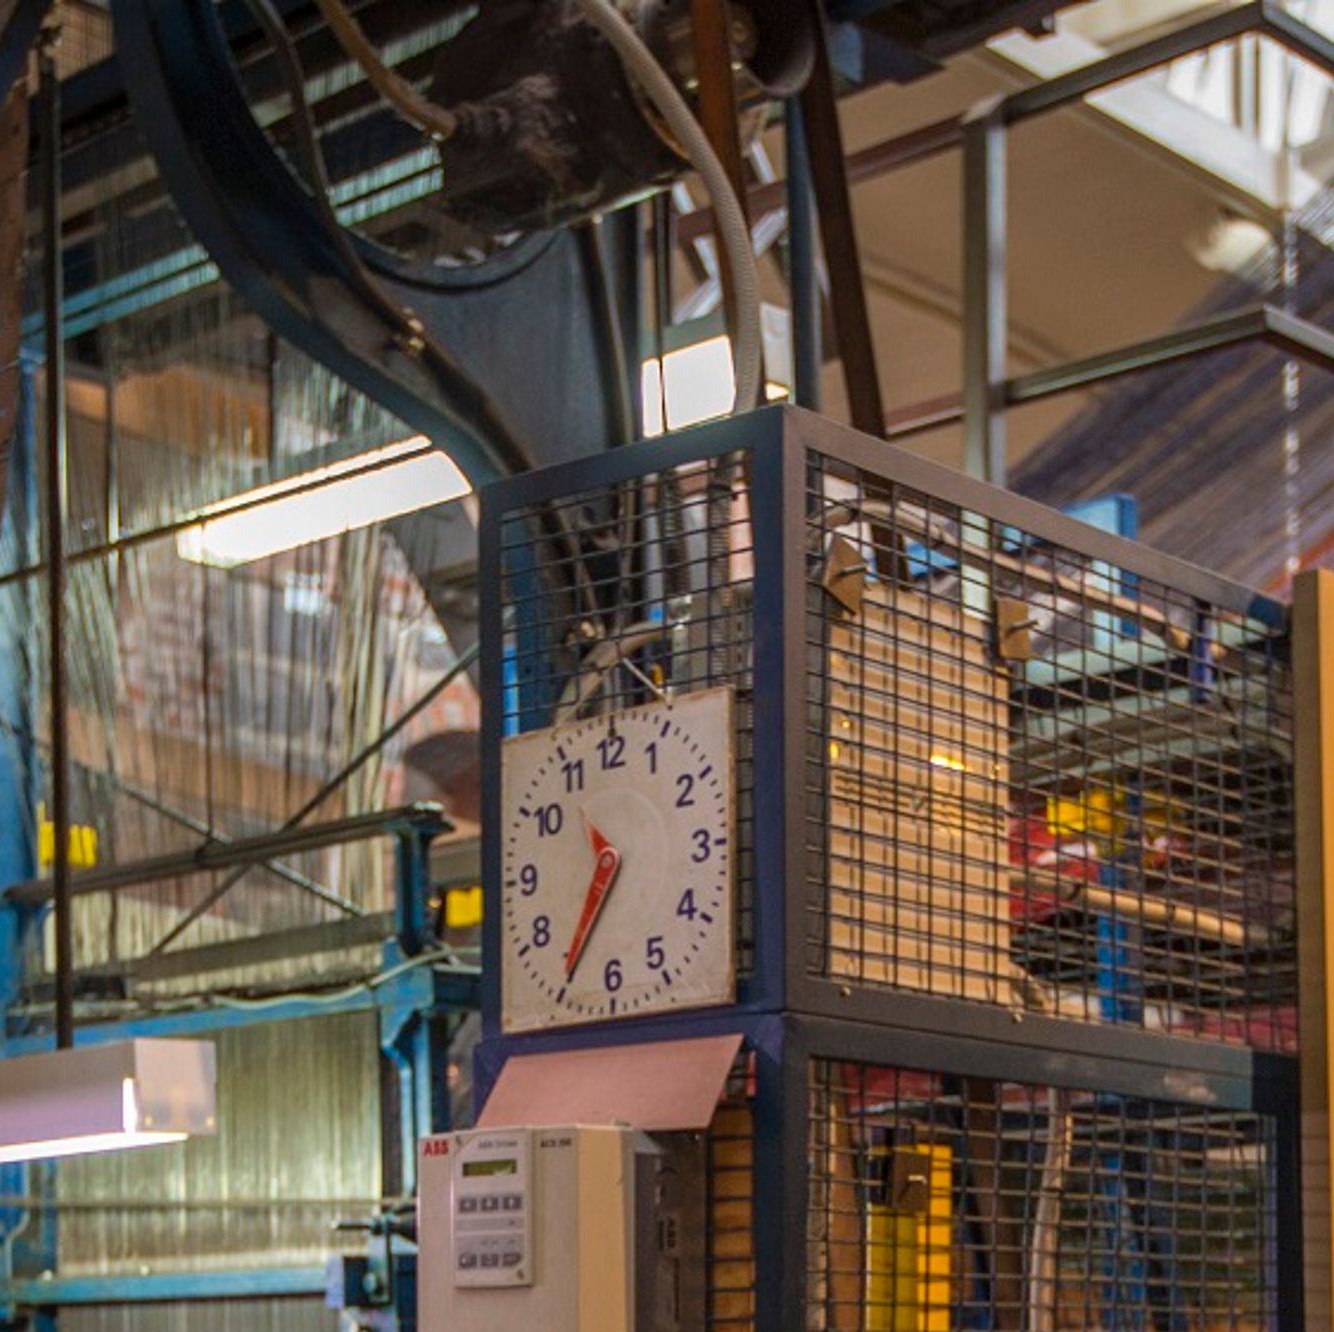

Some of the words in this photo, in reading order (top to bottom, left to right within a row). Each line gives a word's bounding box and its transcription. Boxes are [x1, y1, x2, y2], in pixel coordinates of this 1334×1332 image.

[596, 735, 626, 771] 12
[644, 742, 658, 775] 1
[561, 759, 585, 794] 11
[675, 773, 695, 809] 2
[533, 803, 563, 837] 10
[691, 829, 711, 863] 3
[520, 864, 538, 897] 9
[676, 888, 698, 921] 4
[532, 915, 551, 948] 8
[646, 936, 665, 970] 5
[604, 959, 623, 992] 6
[423, 1139, 449, 1156] ABB
